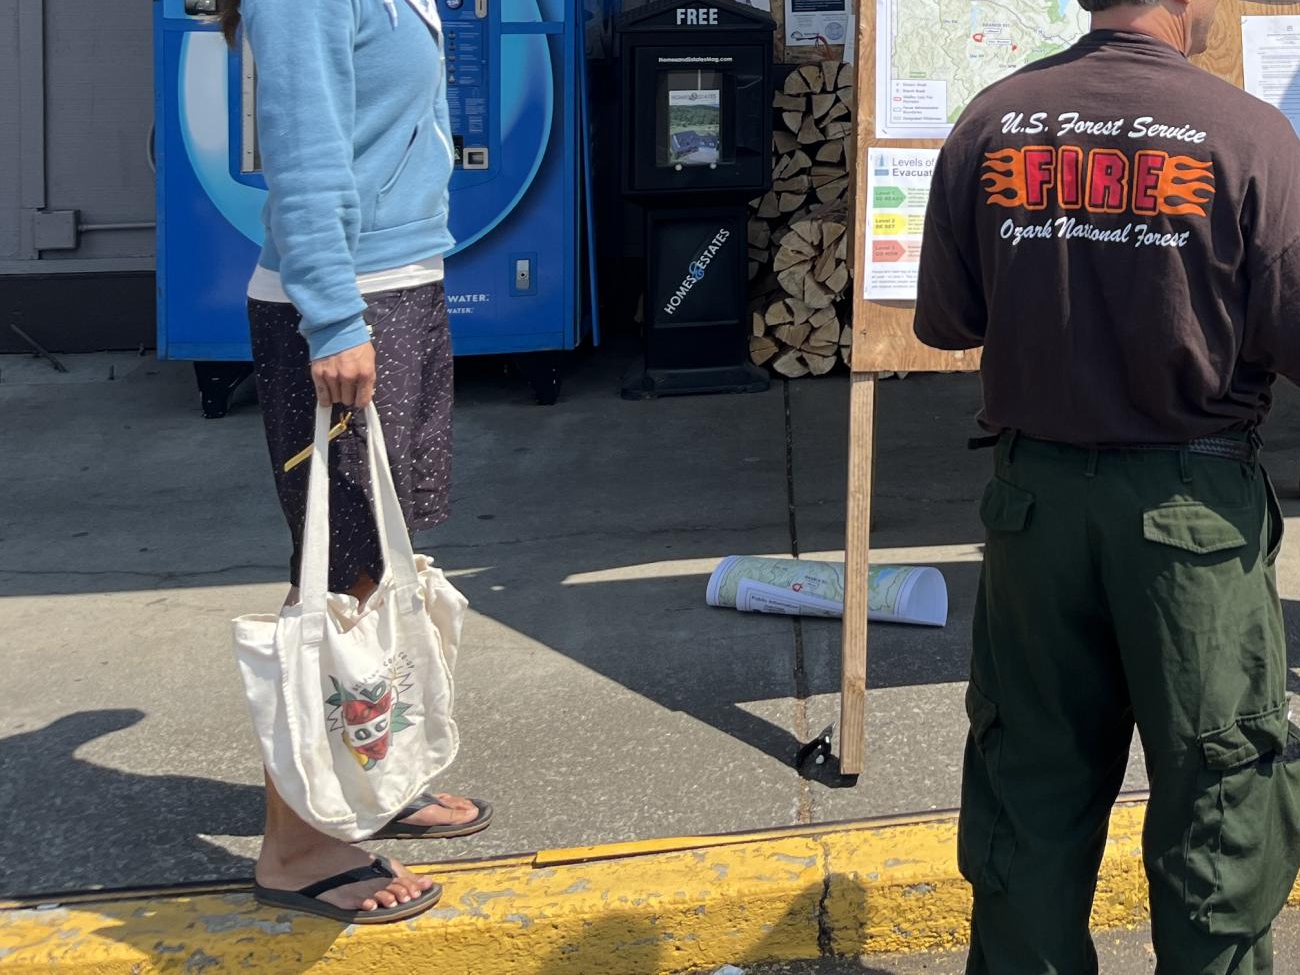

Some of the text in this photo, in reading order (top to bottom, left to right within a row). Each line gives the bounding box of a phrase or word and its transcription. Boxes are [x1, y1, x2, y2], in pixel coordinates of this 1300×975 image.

[676, 8, 718, 25] FREE
[1000, 112, 1207, 143] U.S. Forest Service
[892, 157, 935, 167] Levels of
[892, 168, 933, 177] Evacuat
[1021, 146, 1167, 216] FIRE
[1000, 217, 1190, 247] Ozark National Forest
[664, 274, 697, 314] HOMES
[696, 228, 730, 270] ESTATES
